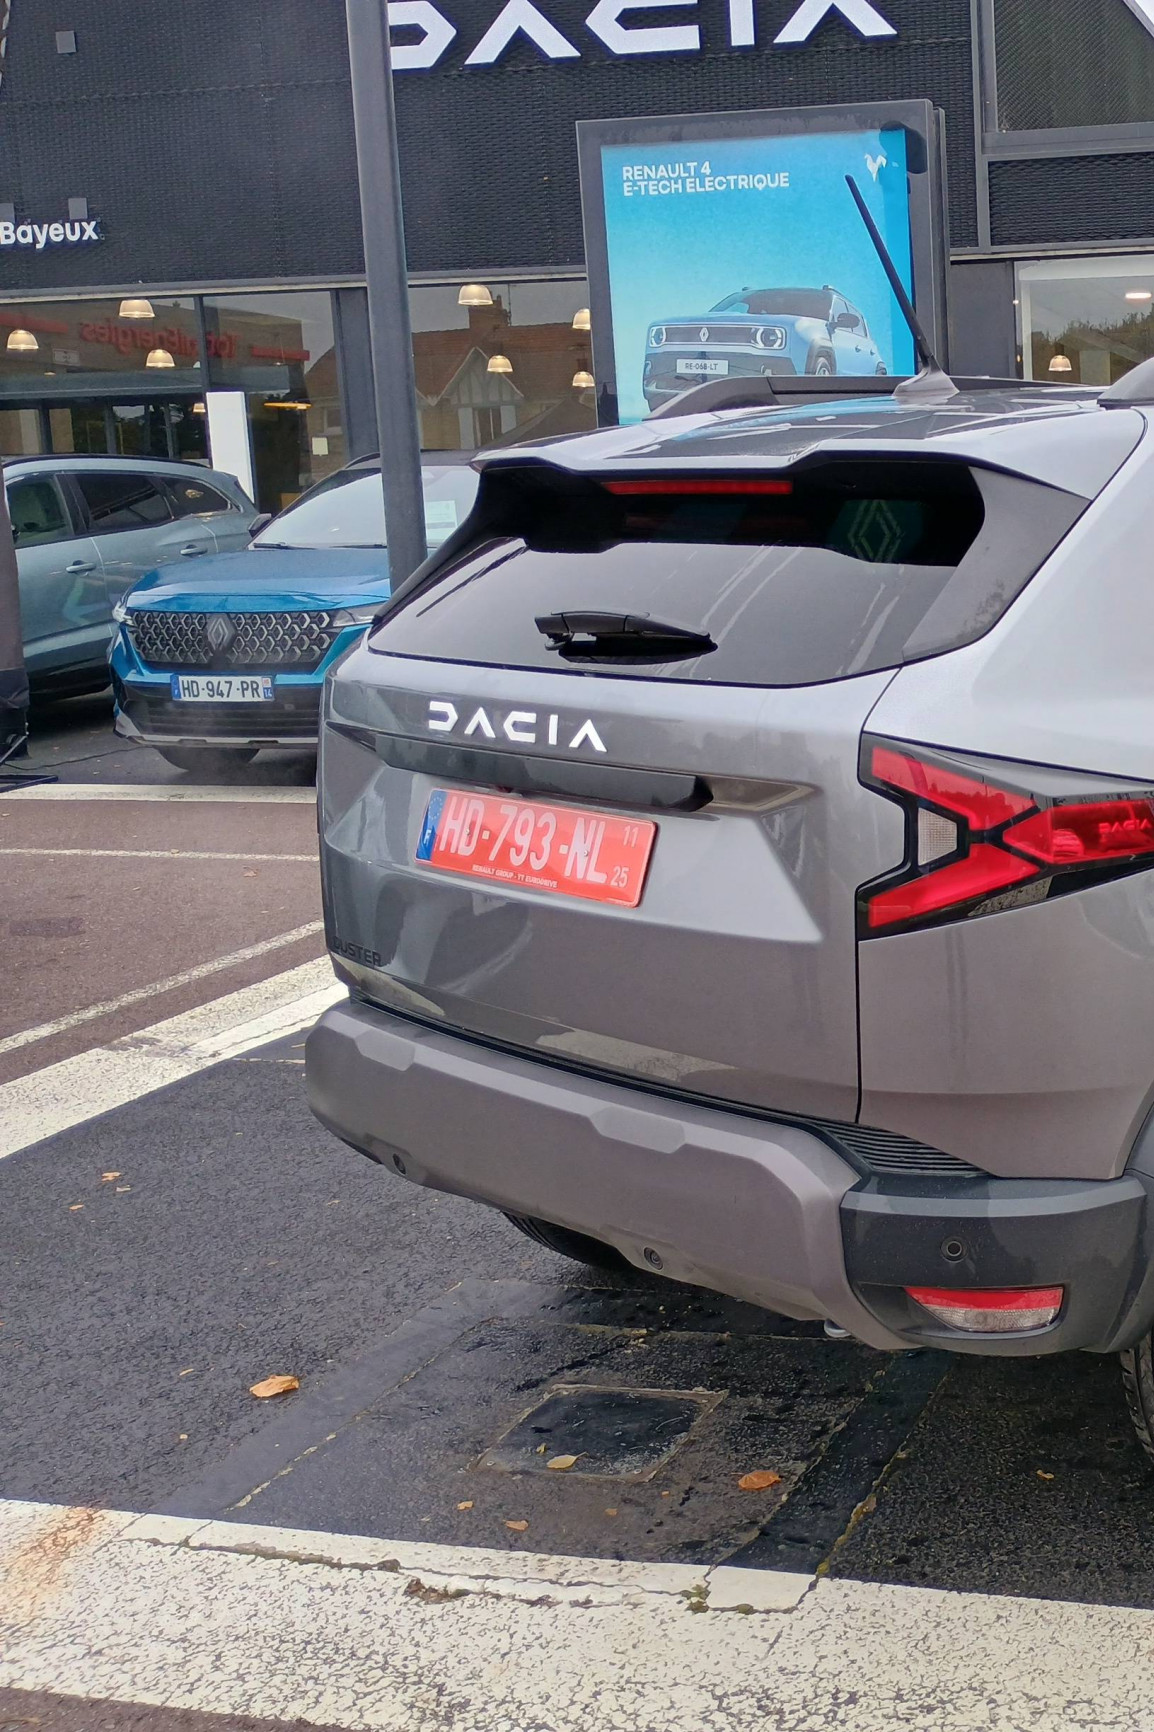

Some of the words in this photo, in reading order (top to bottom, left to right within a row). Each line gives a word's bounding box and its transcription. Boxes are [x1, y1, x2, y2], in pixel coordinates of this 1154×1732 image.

[388, 0, 897, 70] DACIA
[622, 162, 698, 181] RENAULT
[701, 161, 712, 175] 4
[623, 178, 683, 196] E-TECH
[686, 172, 790, 192] ELECTRIQUE
[0, 221, 99, 249] Bayeux
[181, 679, 261, 698] HD-947-PR
[428, 700, 608, 753] DACIA
[439, 796, 608, 884] HD-793-NL
[622, 825, 639, 848] 11
[610, 865, 630, 888] 25
[333, 936, 382, 968] DUSTER
